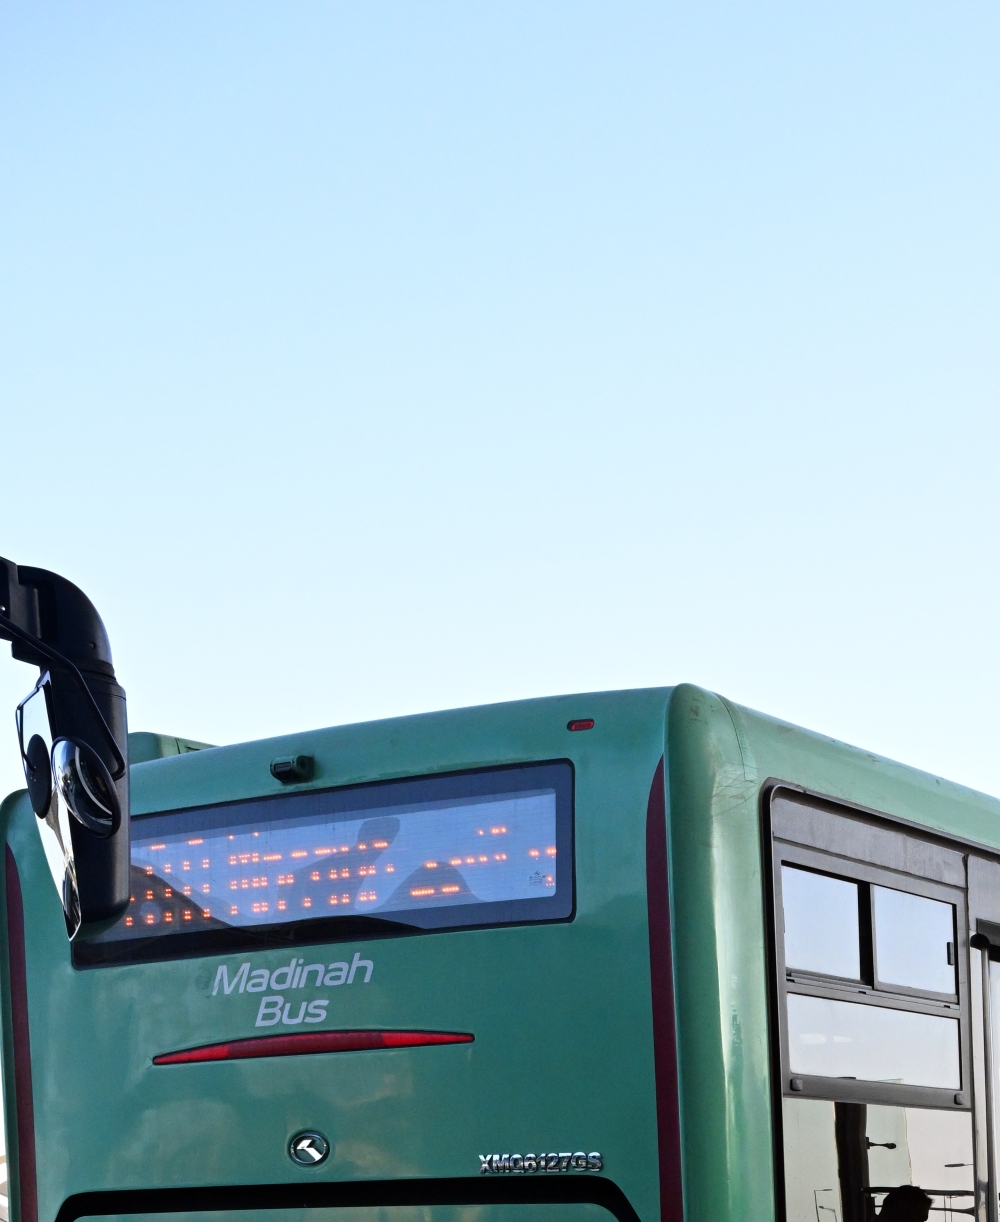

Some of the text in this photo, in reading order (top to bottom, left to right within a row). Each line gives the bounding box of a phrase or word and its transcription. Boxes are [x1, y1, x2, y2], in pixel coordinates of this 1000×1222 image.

[212, 952, 374, 996] Madinah
[255, 995, 329, 1027] Bus
[478, 1151, 603, 1174] XMQ6127GS
